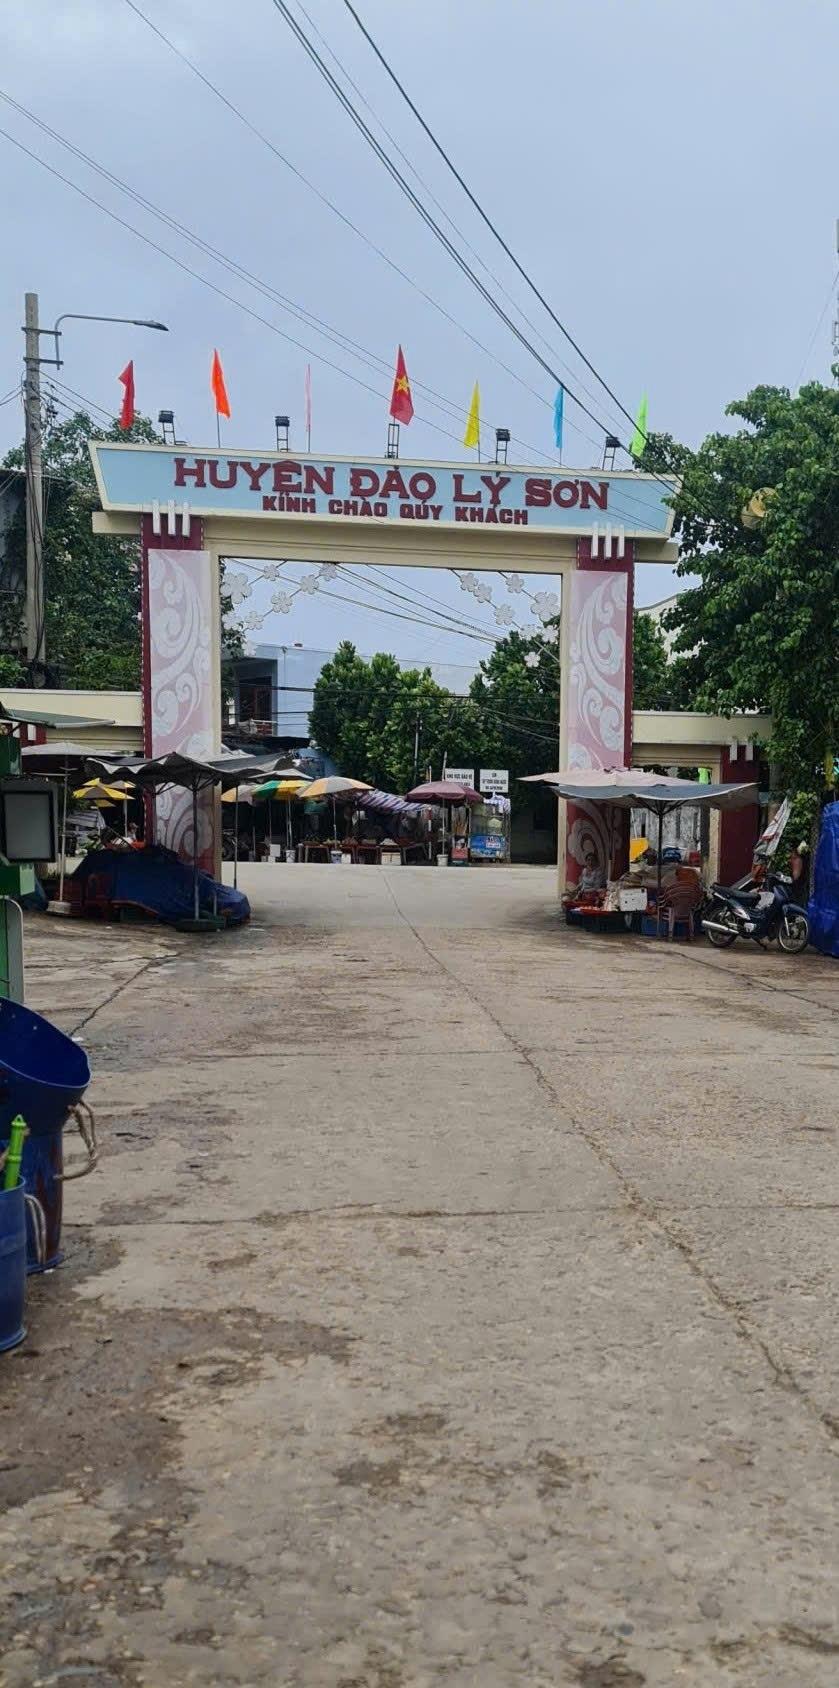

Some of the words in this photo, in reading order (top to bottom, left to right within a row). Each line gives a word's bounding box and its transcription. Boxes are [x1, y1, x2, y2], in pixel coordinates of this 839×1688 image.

[262, 491, 316, 513] KÍNH
[328, 497, 388, 517] CHÀO
[455, 504, 528, 525] KHÁCH
[453, 471, 511, 504] LÝ
[525, 478, 609, 510] SƠN
